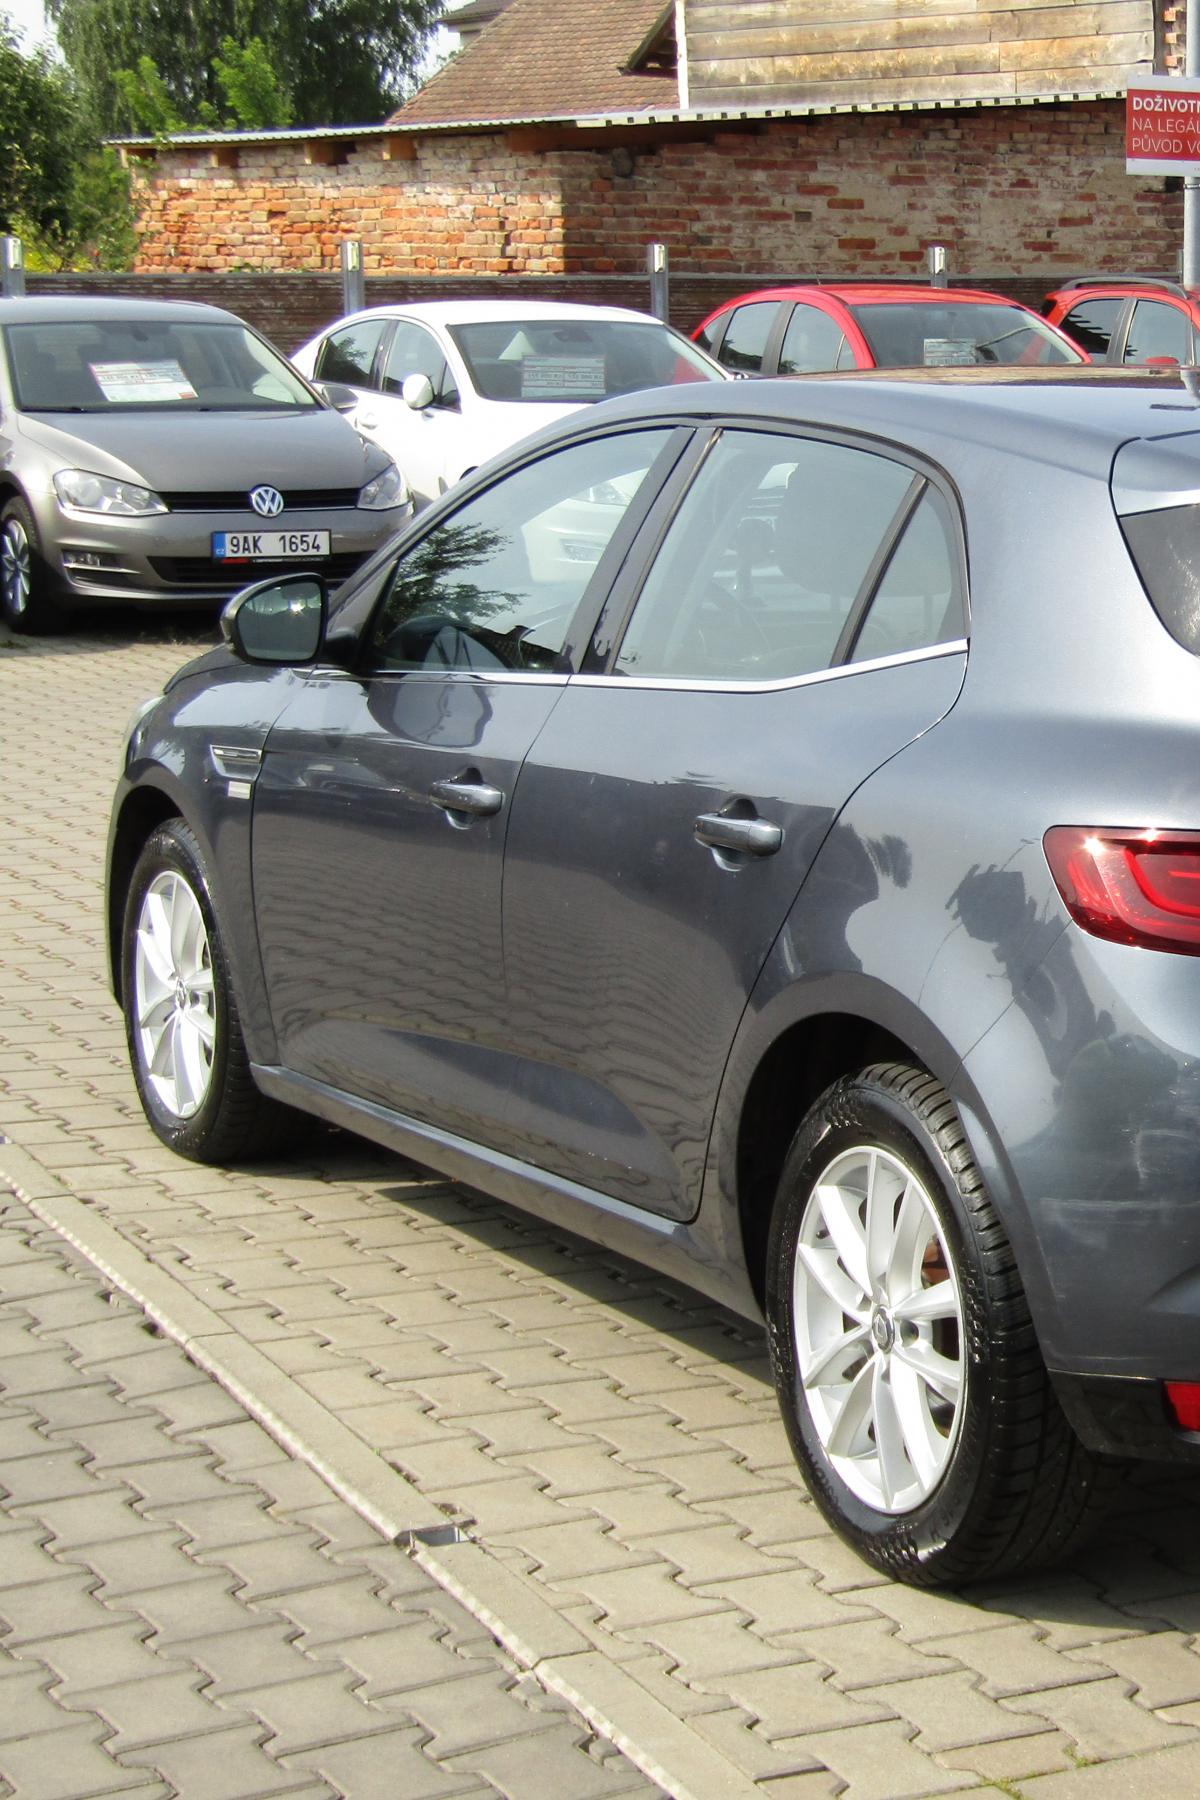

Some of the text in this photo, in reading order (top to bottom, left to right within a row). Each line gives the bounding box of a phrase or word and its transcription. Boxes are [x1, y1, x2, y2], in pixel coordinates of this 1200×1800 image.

[1131, 117, 1153, 132] NA
[1131, 134, 1183, 154] PŮVOD
[229, 534, 321, 554] 9AK 1654
